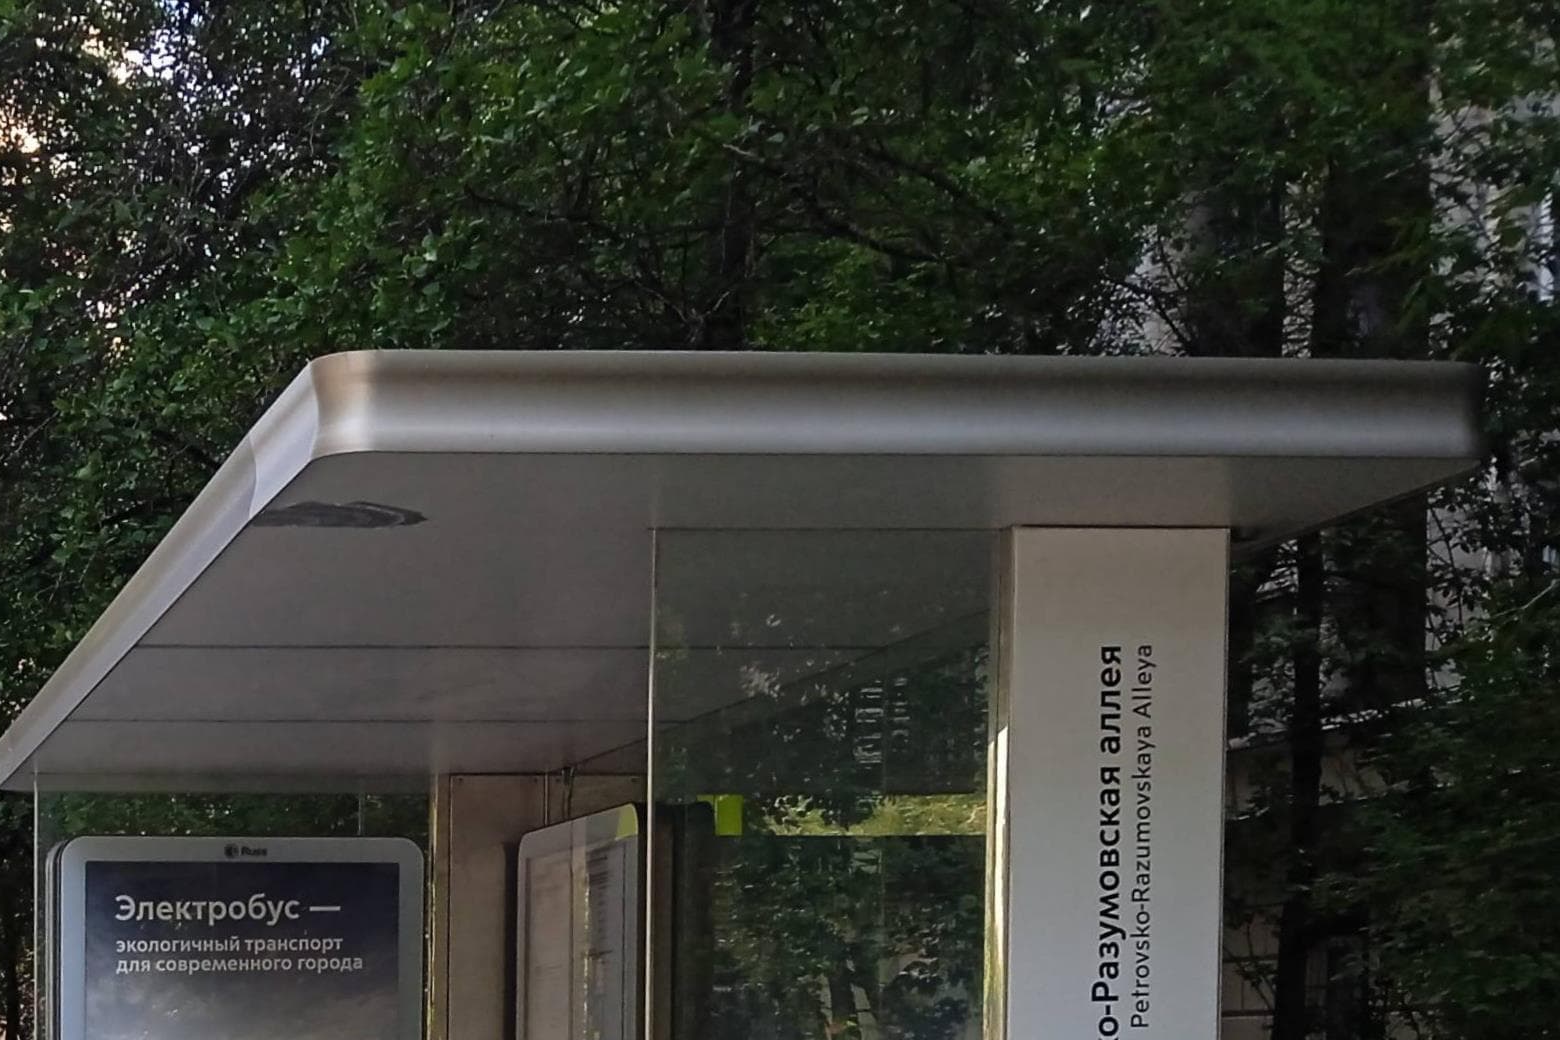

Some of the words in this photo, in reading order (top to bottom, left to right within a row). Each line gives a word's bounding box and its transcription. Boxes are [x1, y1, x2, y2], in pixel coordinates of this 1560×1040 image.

[1100, 645, 1122, 754] аллея
[1131, 644, 1157, 719] Alleya
[1130, 725, 1157, 1028] Petrovsko-Razumovskaya
[114, 894, 301, 926] Электробус
[115, 936, 240, 953] экологичный
[244, 938, 343, 955] транспорт
[115, 960, 151, 975] для
[156, 958, 293, 975] современного
[297, 957, 364, 974] города
